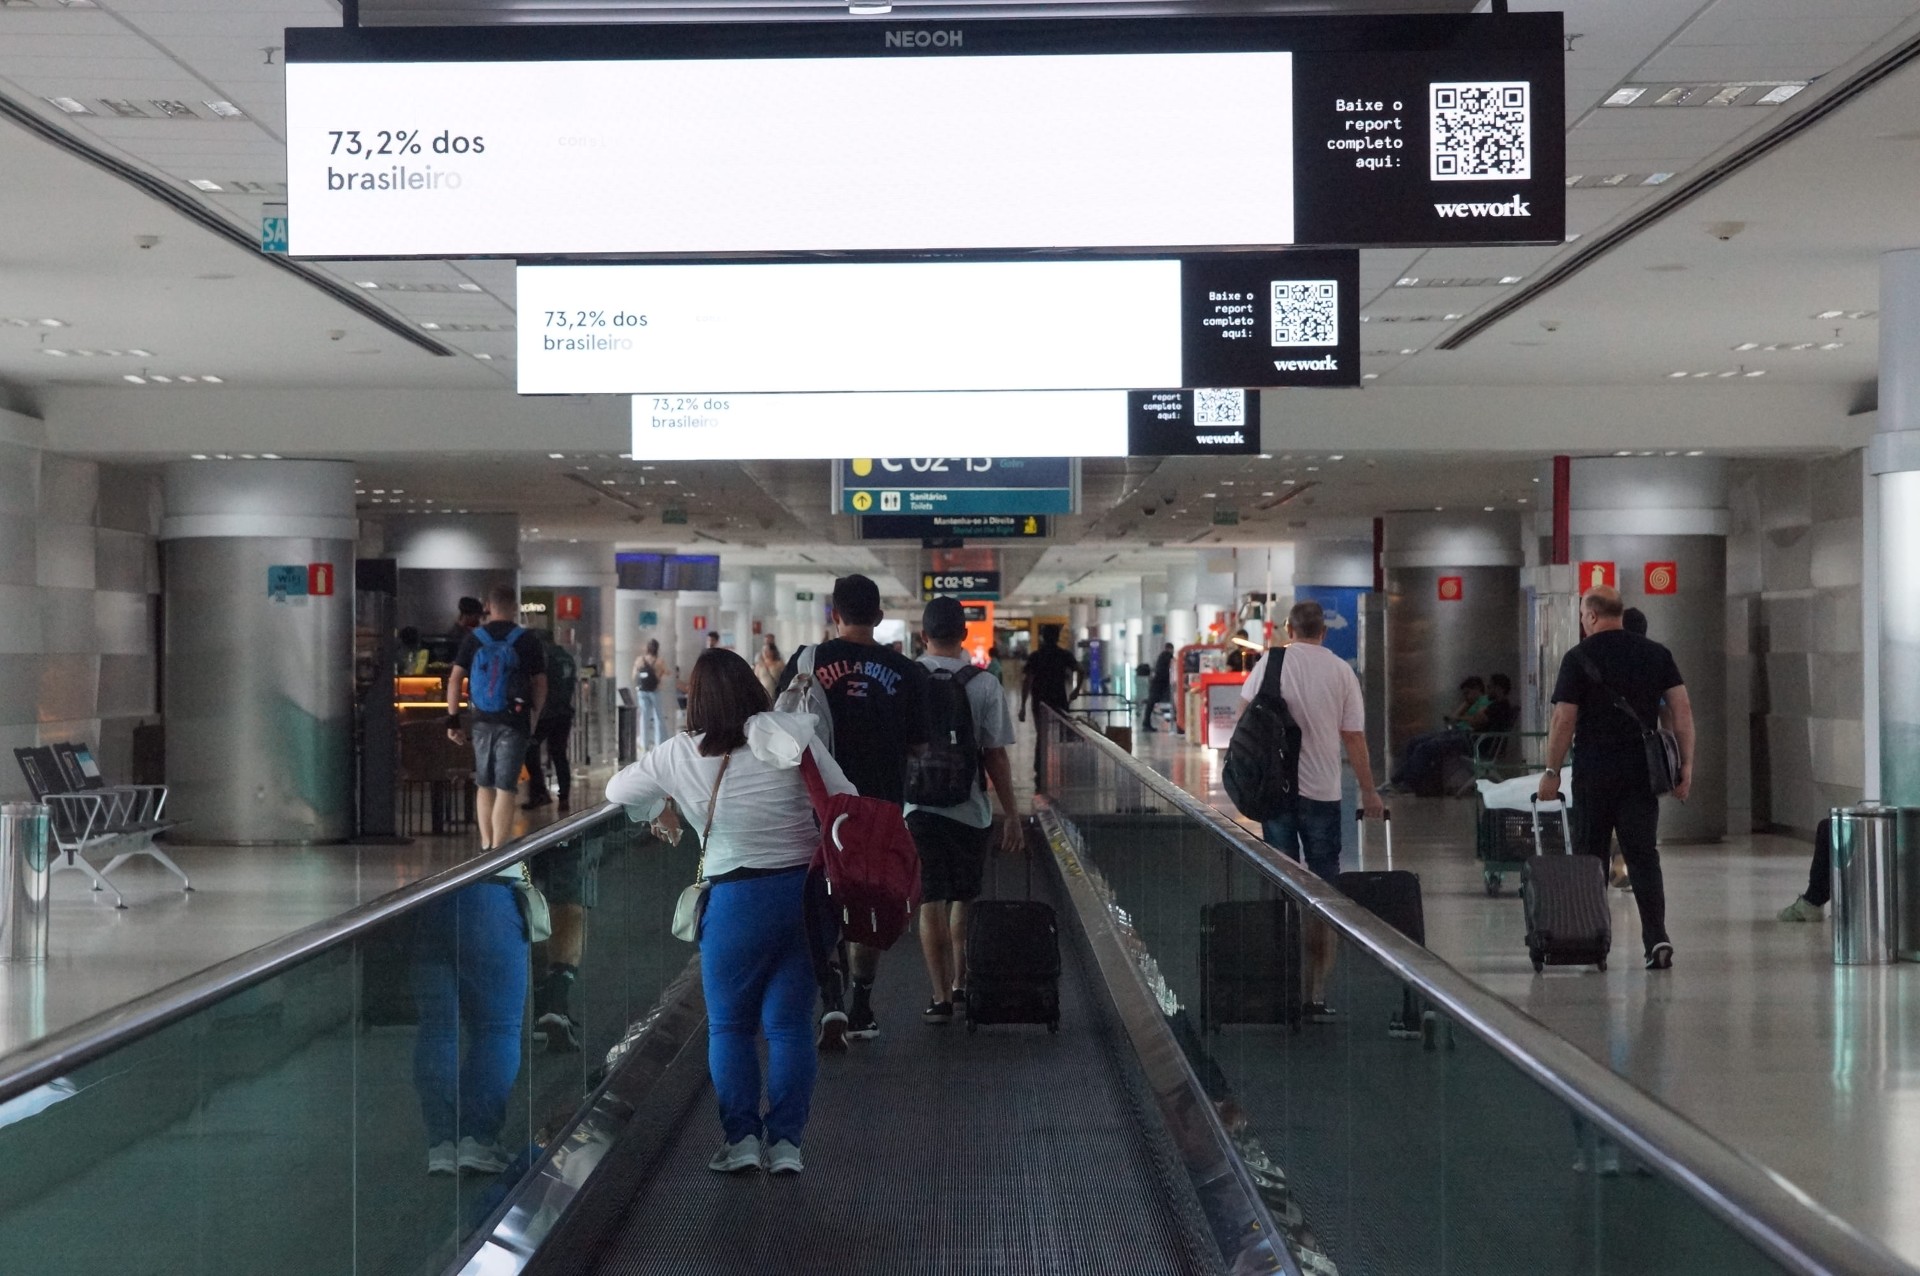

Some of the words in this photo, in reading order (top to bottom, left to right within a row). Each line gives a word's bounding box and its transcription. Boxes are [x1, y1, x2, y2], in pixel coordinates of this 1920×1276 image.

[885, 30, 963, 48] NEOOH
[1335, 99, 1383, 111] Baixe
[1393, 100, 1403, 111] o
[1345, 117, 1402, 133] report
[328, 130, 422, 160] 73,2%
[432, 130, 485, 154] dos
[1327, 136, 1403, 152] completo
[1356, 155, 1401, 171] aqui:
[328, 165, 462, 190] brasileiro
[1434, 194, 1531, 217] wework
[1209, 291, 1241, 301] Baixe
[1246, 293, 1254, 301] o
[1215, 304, 1253, 314] report
[544, 311, 606, 330] 73,2%
[613, 311, 648, 327] dos
[1202, 316, 1254, 327] completo
[1221, 328, 1253, 339] aqui:
[544, 334, 633, 350] brasileiro
[1273, 354, 1338, 371] wework
[652, 398, 698, 412] 73,2%
[703, 398, 730, 410] dos
[1152, 394, 1181, 402] report
[1143, 402, 1182, 411] completo
[1196, 431, 1245, 445] wework
[909, 492, 948, 501] Sanitários
[910, 502, 933, 510] Toilets
[933, 576, 944, 589] C
